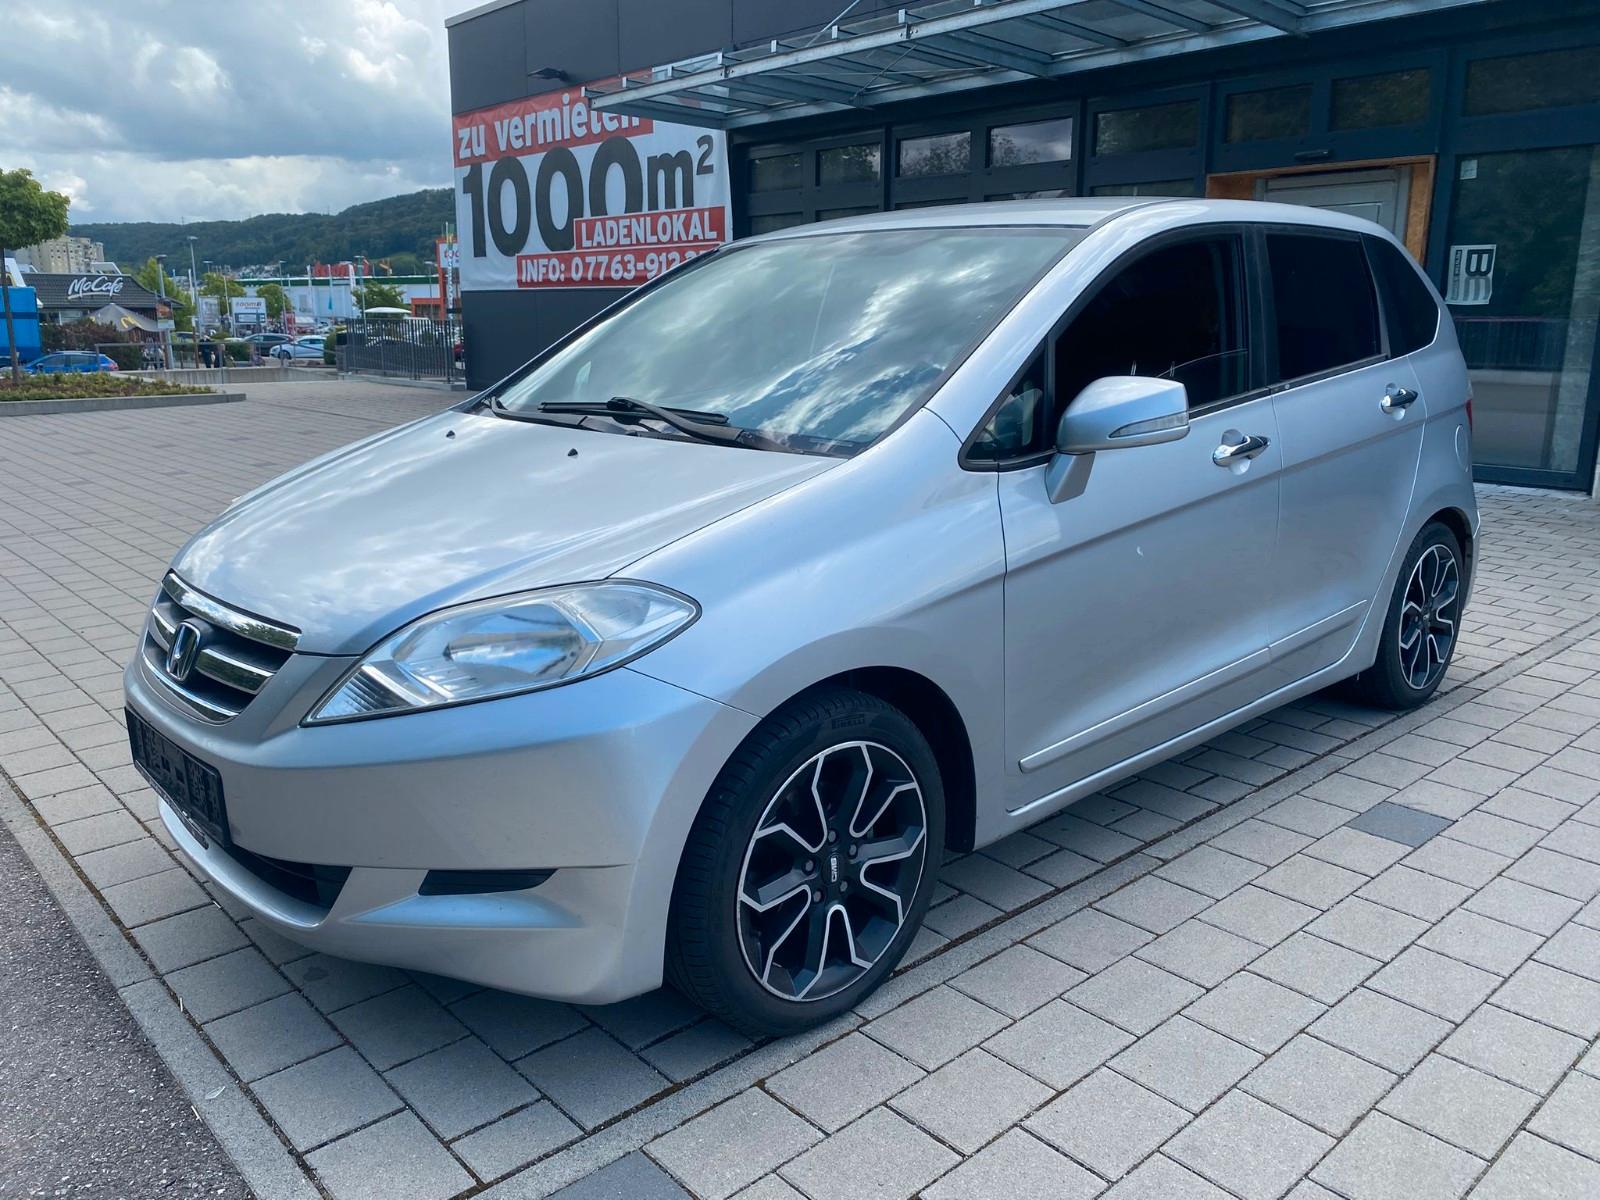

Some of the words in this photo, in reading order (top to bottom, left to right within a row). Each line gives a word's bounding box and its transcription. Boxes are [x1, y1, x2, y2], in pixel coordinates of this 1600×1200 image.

[458, 124, 486, 160] zu
[581, 211, 717, 248] LADENLOKAL
[521, 258, 565, 283] INFO:
